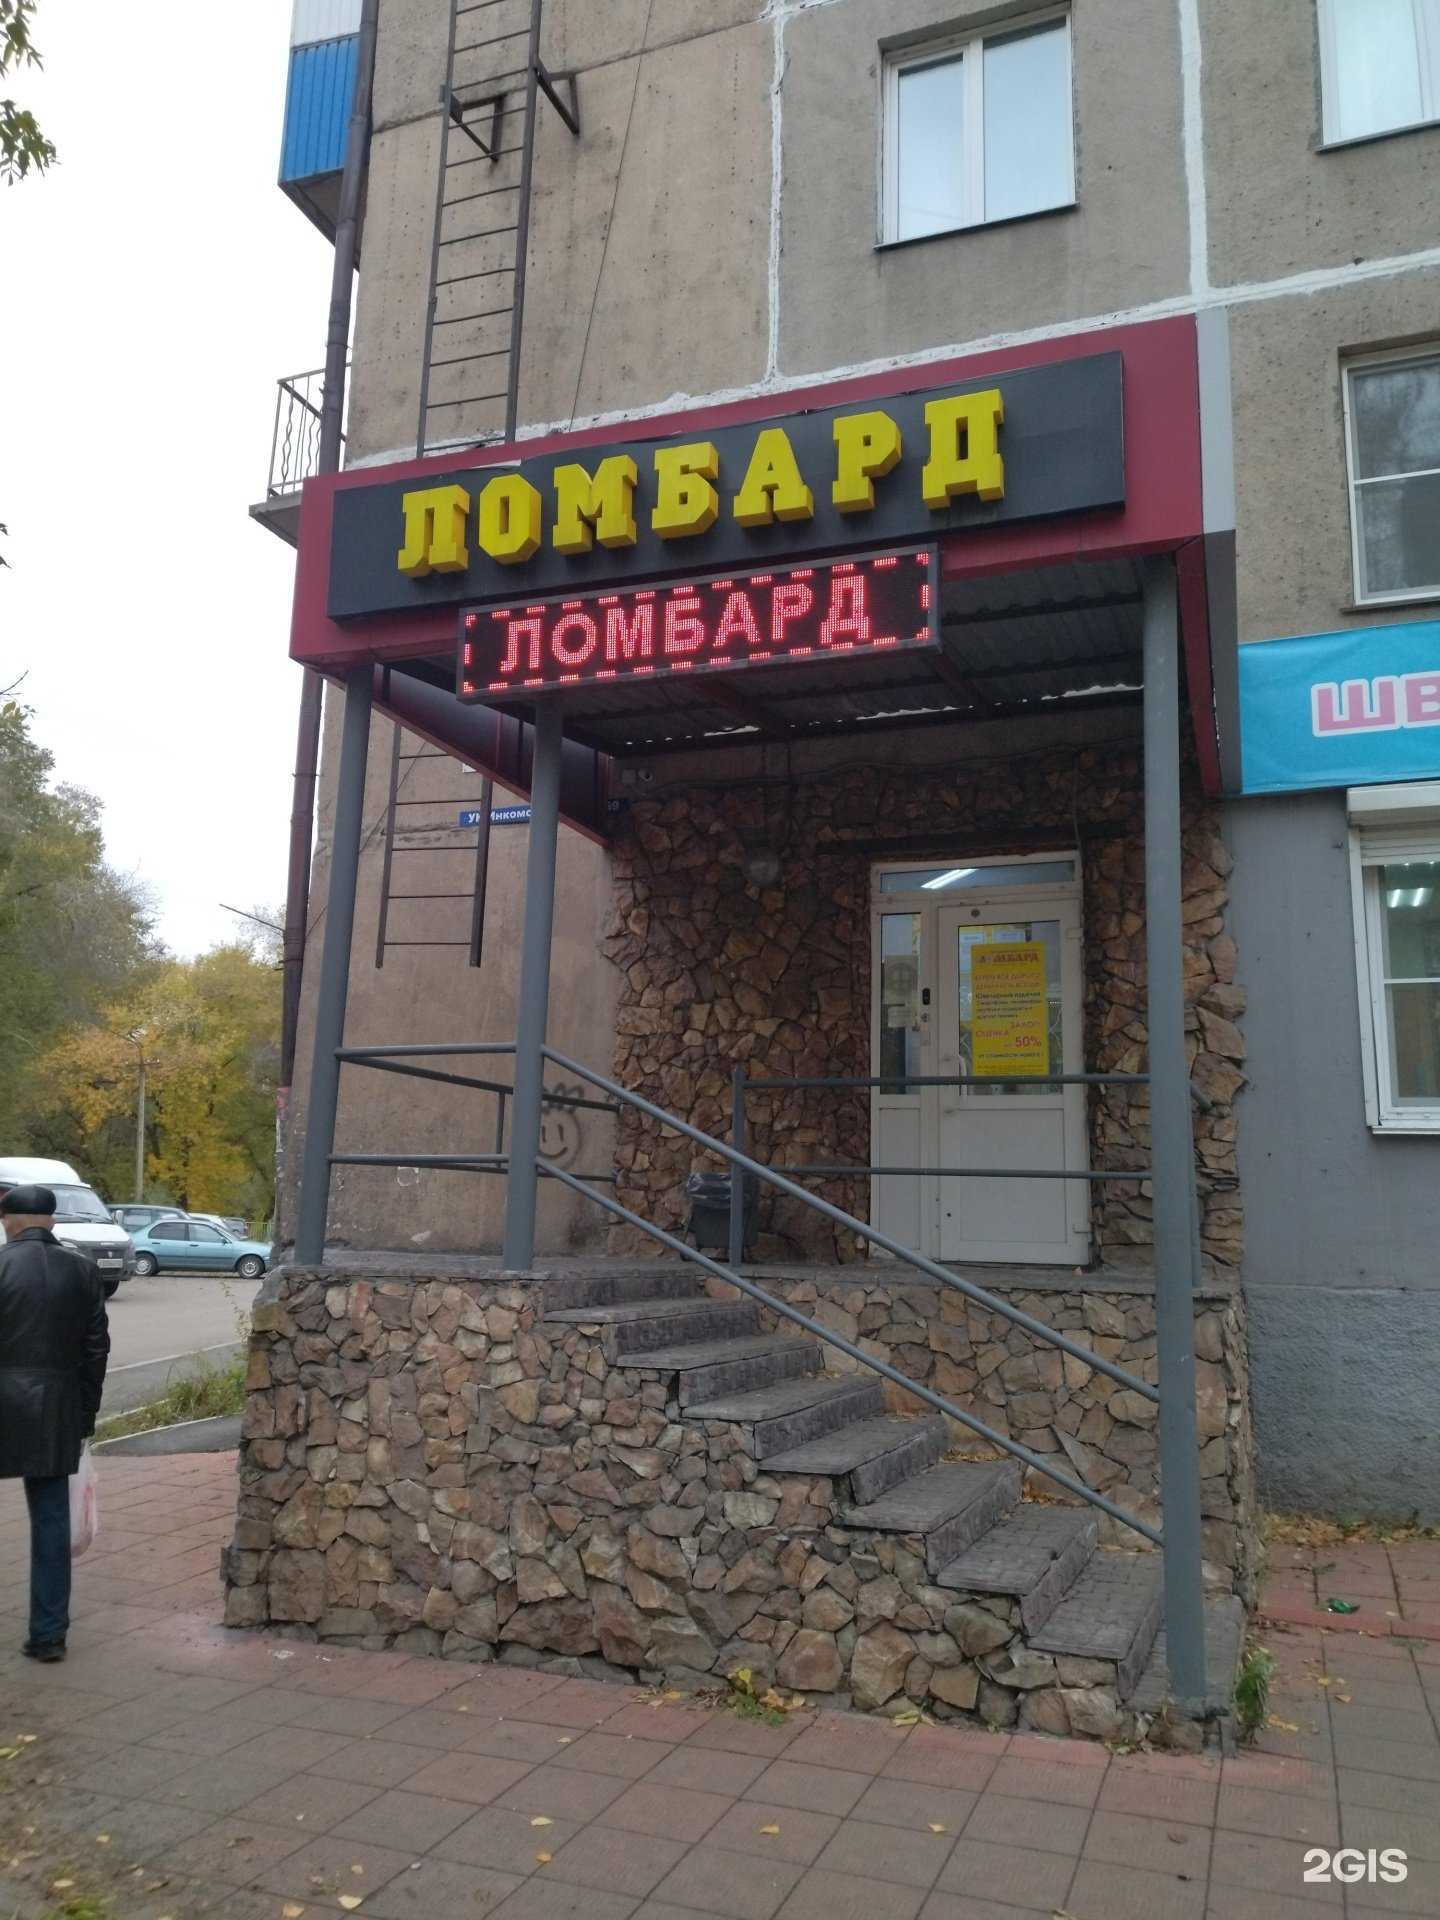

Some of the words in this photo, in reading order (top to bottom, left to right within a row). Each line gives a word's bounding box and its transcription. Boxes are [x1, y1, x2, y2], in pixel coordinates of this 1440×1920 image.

[397, 388, 1005, 578] ЛОМБАРД
[500, 575, 870, 674] ЛОМБАРД
[1015, 1035, 1042, 1048] 50%
